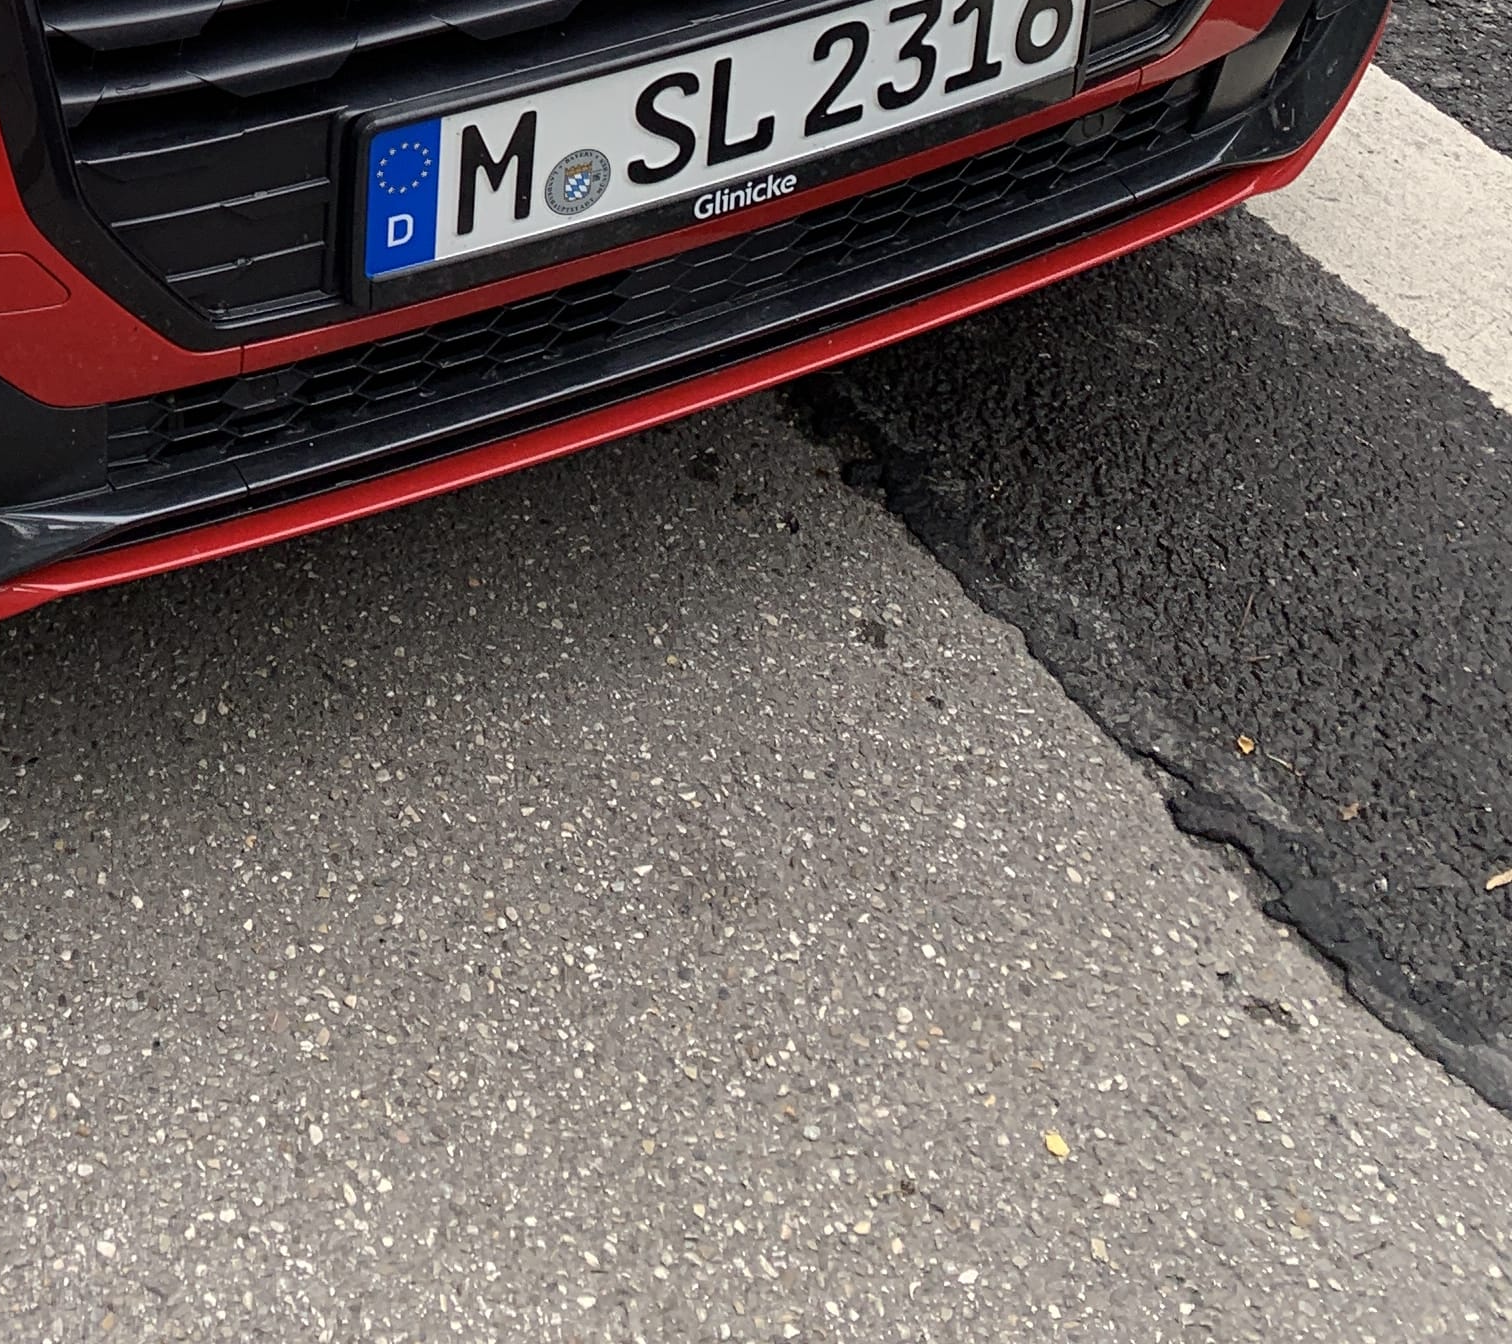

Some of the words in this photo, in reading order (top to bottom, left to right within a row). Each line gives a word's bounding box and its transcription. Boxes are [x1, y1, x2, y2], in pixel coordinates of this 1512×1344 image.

[456, 111, 538, 236] M
[626, 57, 775, 186] SL
[693, 174, 798, 220] Glinicke
[386, 213, 414, 249] D
